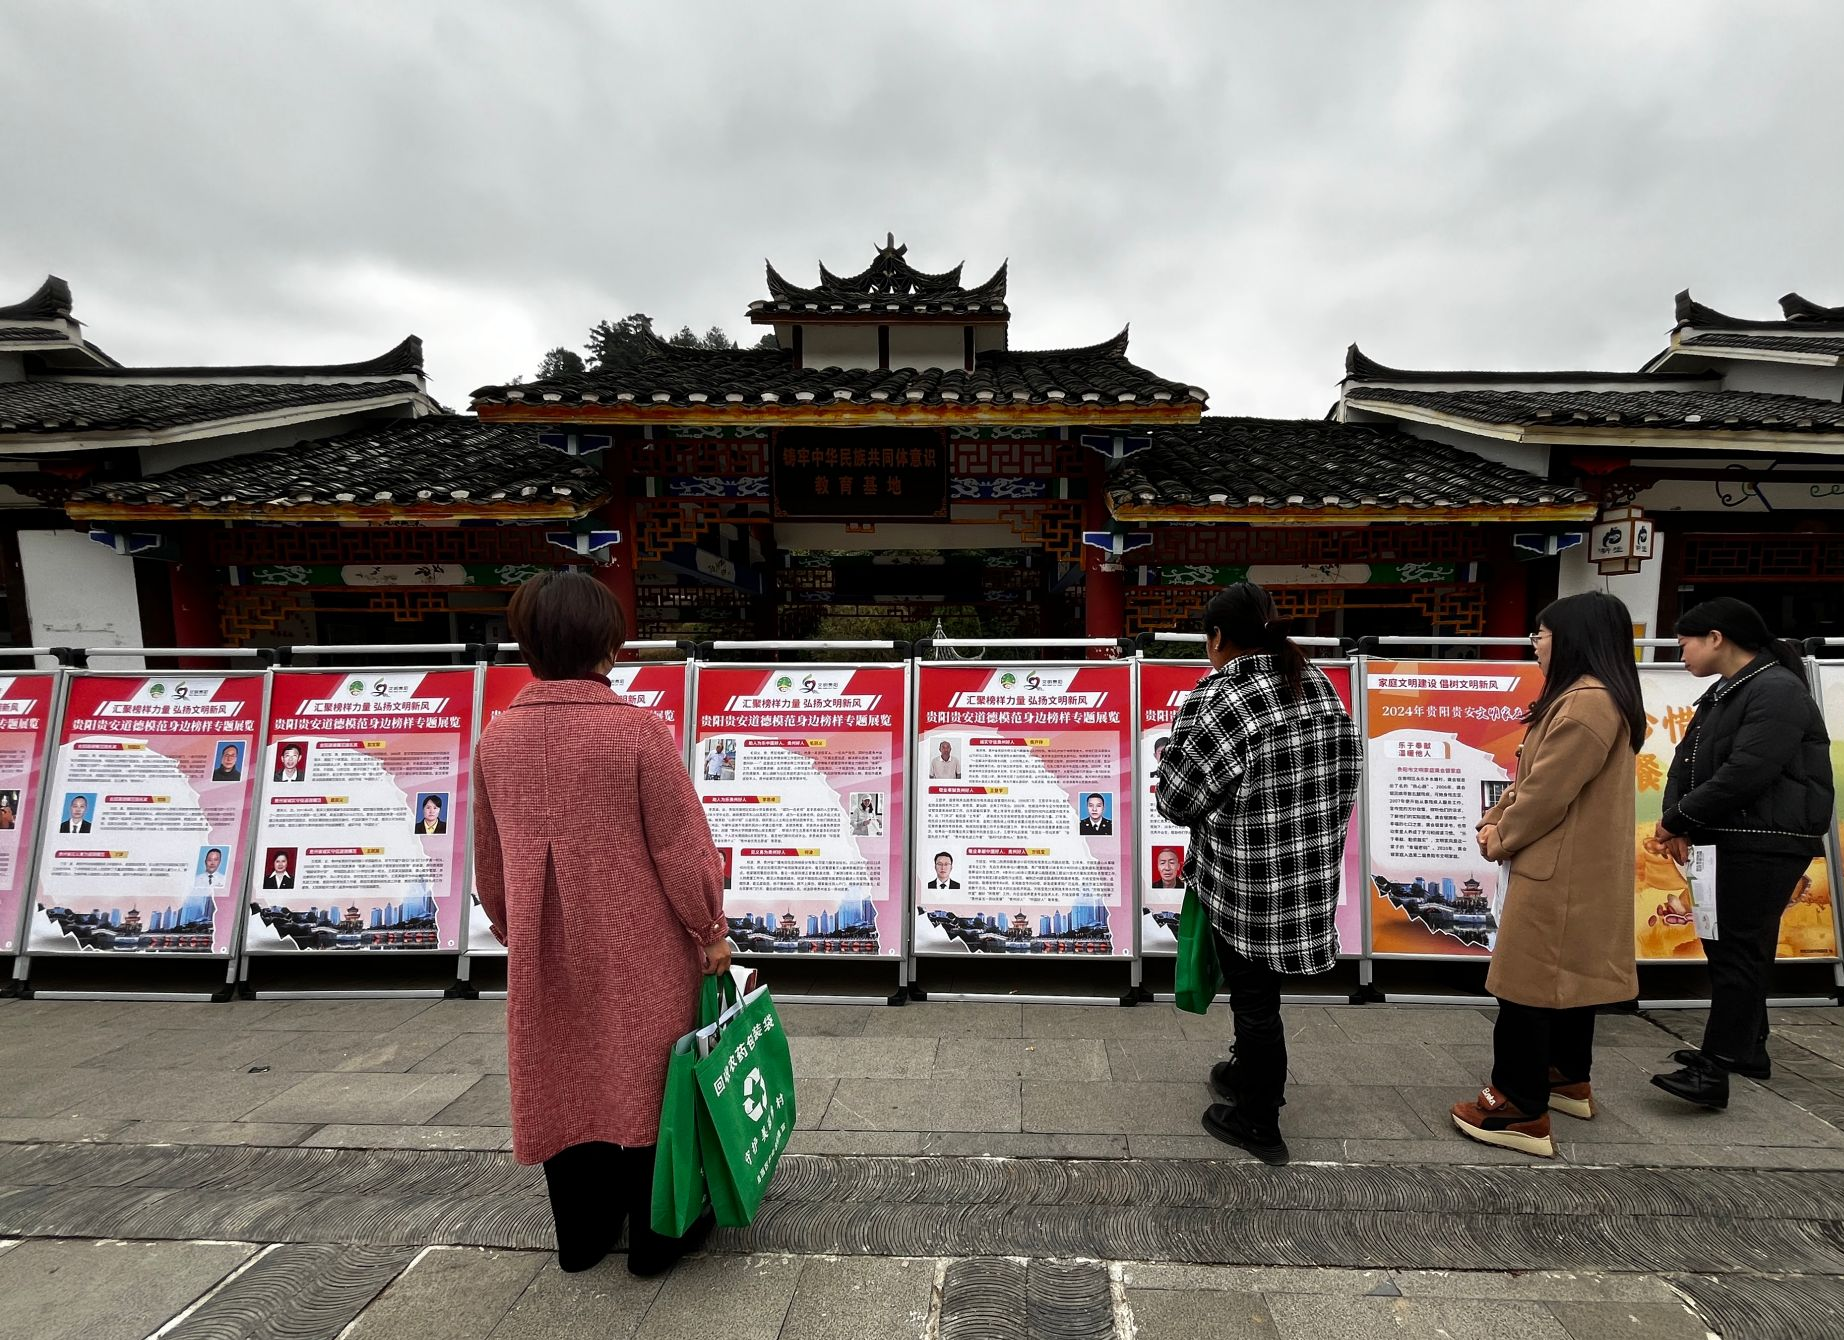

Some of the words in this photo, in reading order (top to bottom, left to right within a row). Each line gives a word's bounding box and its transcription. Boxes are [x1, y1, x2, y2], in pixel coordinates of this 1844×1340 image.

[783, 447, 937, 468] 铸牢中华民族共同体意识
[814, 475, 902, 495] 教育基地
[1378, 678, 1437, 689] 家庭文明建设
[1440, 679, 1499, 690] 倡树文明新风
[314, 702, 371, 713] 汇聚榜样力量
[373, 700, 430, 712] 弘扬文明新风
[742, 697, 801, 709] 汇聚榜样力量
[803, 697, 862, 709] 弘扬文明新风
[966, 694, 1026, 706] 汇聚榜样力量
[1028, 694, 1088, 706] 弘扬文明新风
[0, 703, 18, 712] 新风
[112, 704, 171, 715] 汇聚榜样力量
[173, 704, 227, 715] 弘扬文明新风
[274, 716, 461, 730] 贵阳贵安道德模范身边榜样专题展览
[701, 714, 892, 728] 贵阳贵安道德模范身边榜样专题展览
[926, 710, 1120, 725] 贵阳贵安道德模范身边榜样专题展览
[72, 718, 255, 733] 贵阳贵安道德模范身边榜样专题展览
[1398, 741, 1432, 750] 乐于奉献
[1398, 750, 1432, 758] 温暖他人
[713, 1013, 775, 1097] 回收农药包装袋
